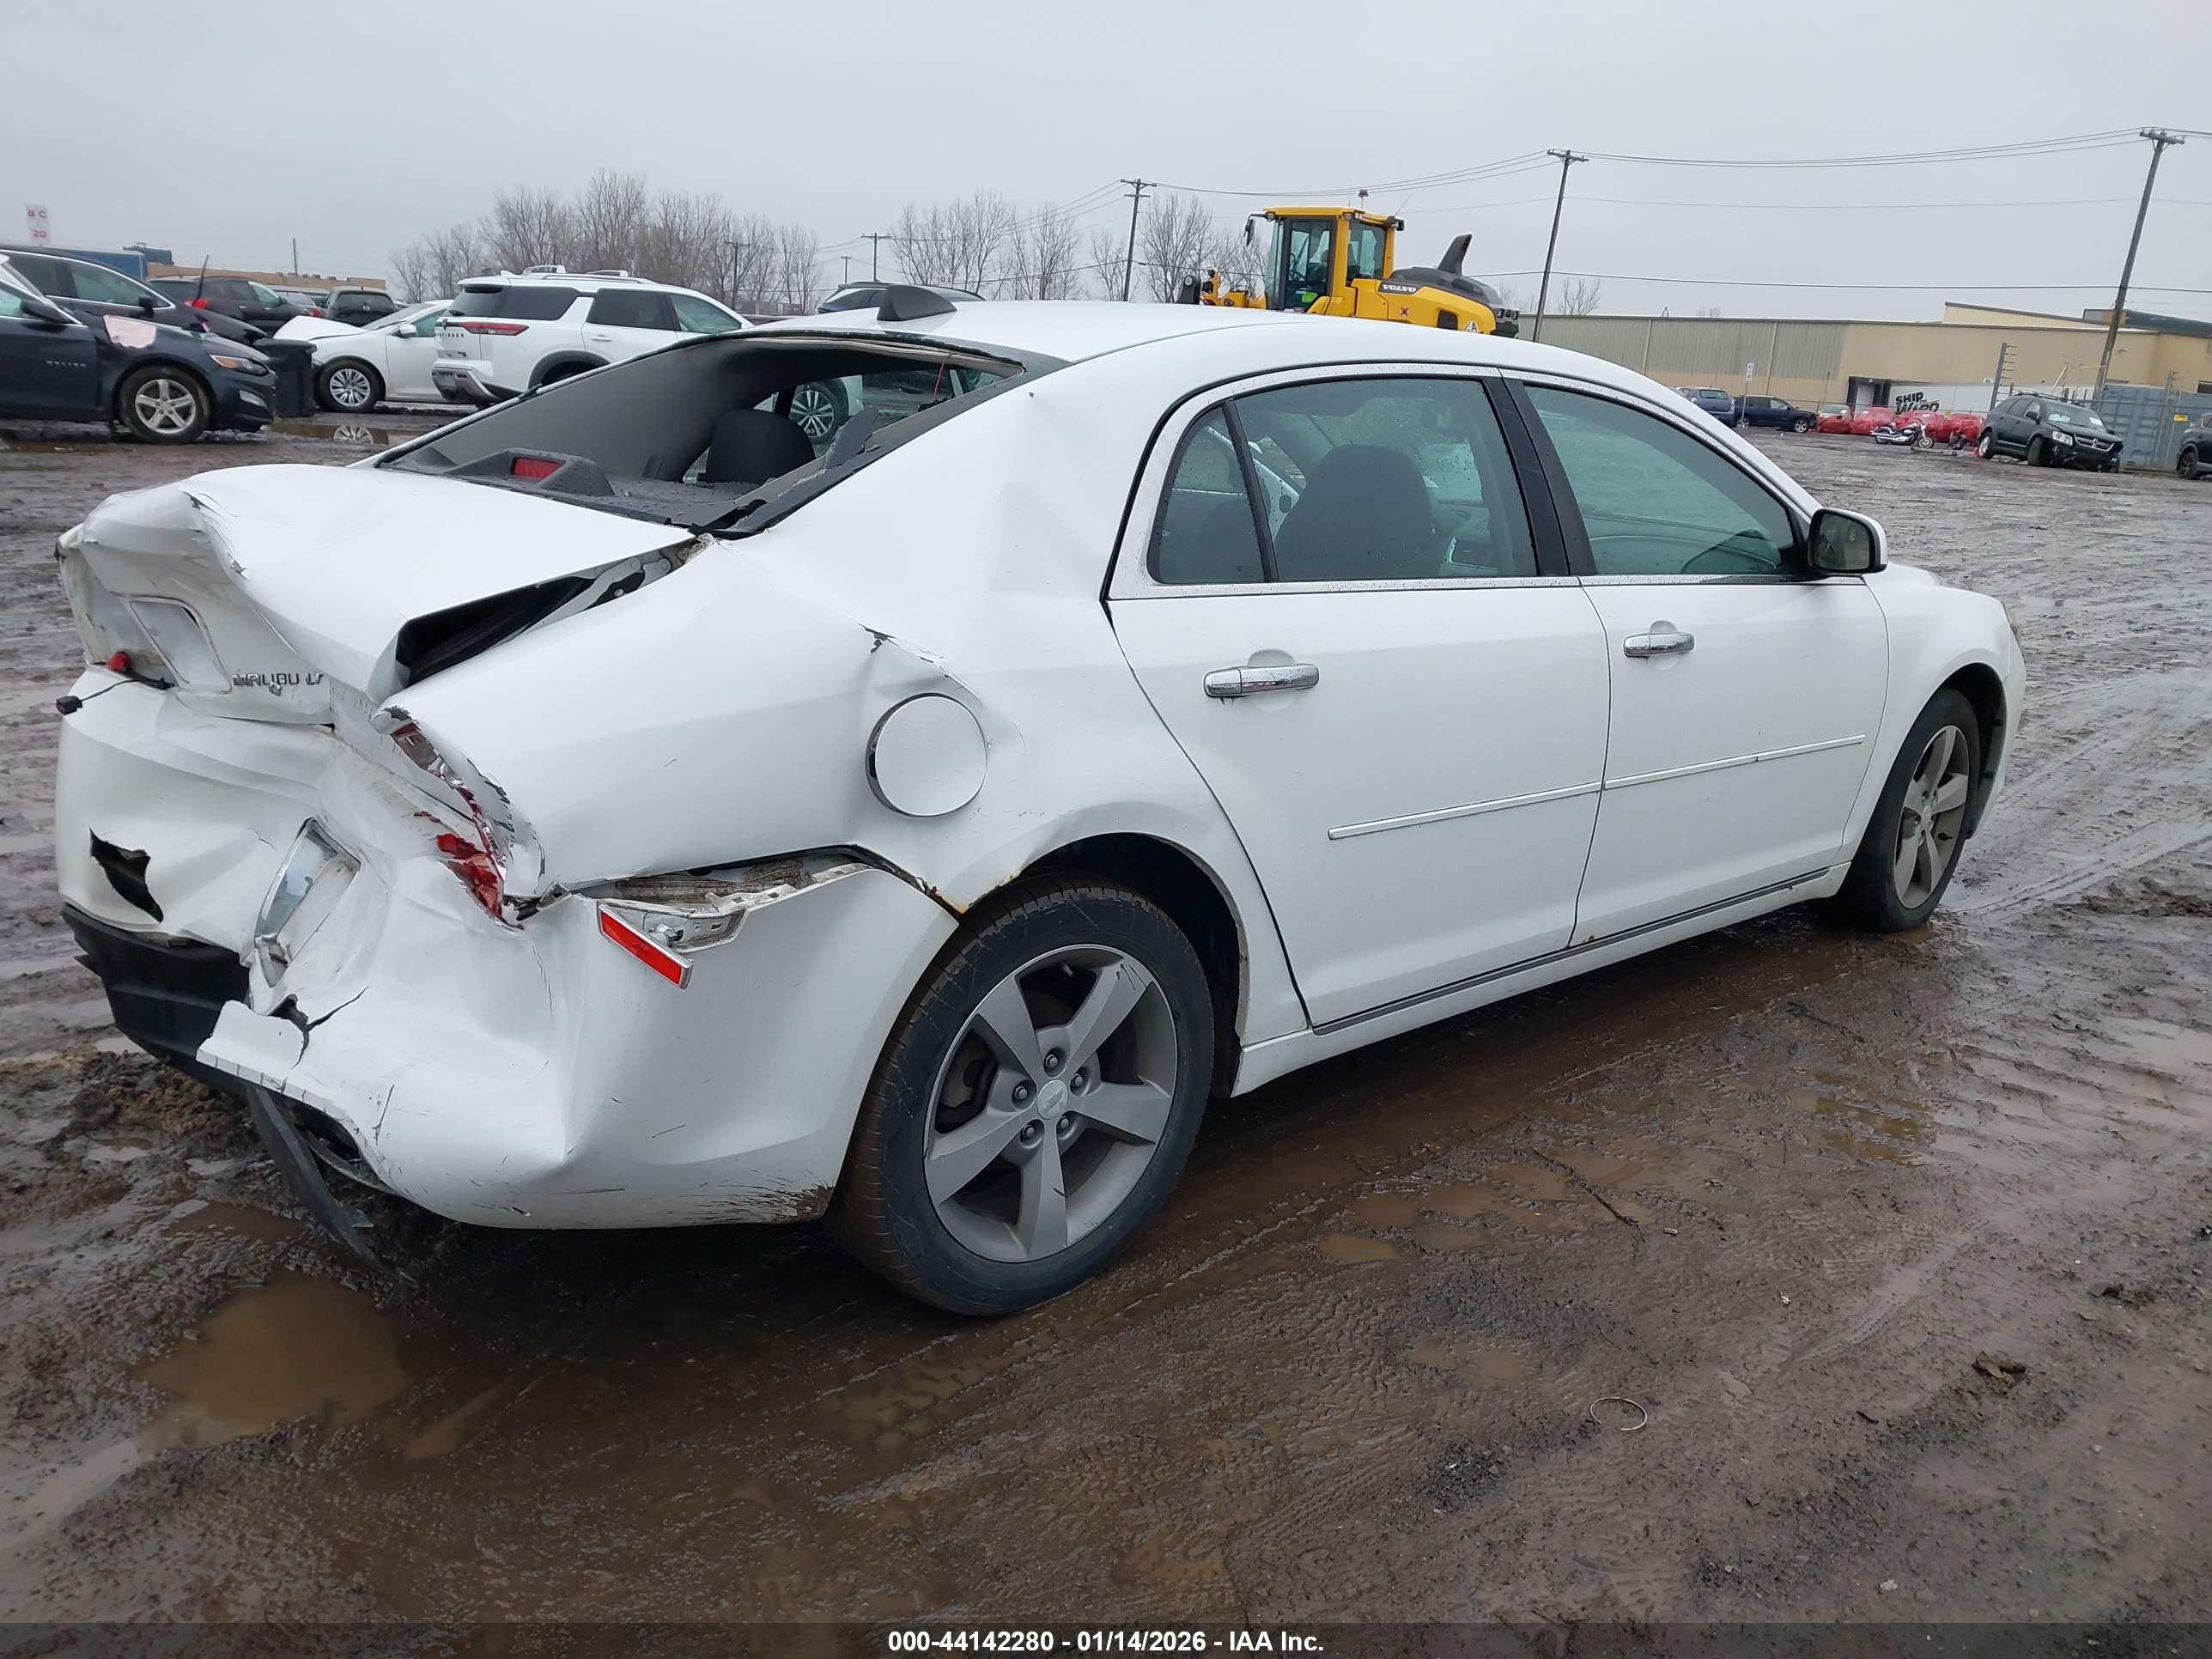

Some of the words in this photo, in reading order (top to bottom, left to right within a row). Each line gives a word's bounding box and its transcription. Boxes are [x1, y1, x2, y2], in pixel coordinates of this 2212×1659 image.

[1382, 283, 1417, 293] VOLVO
[1895, 391, 1924, 405] SHIP
[232, 672, 300, 687] MALIBU
[305, 672, 324, 686] LT
